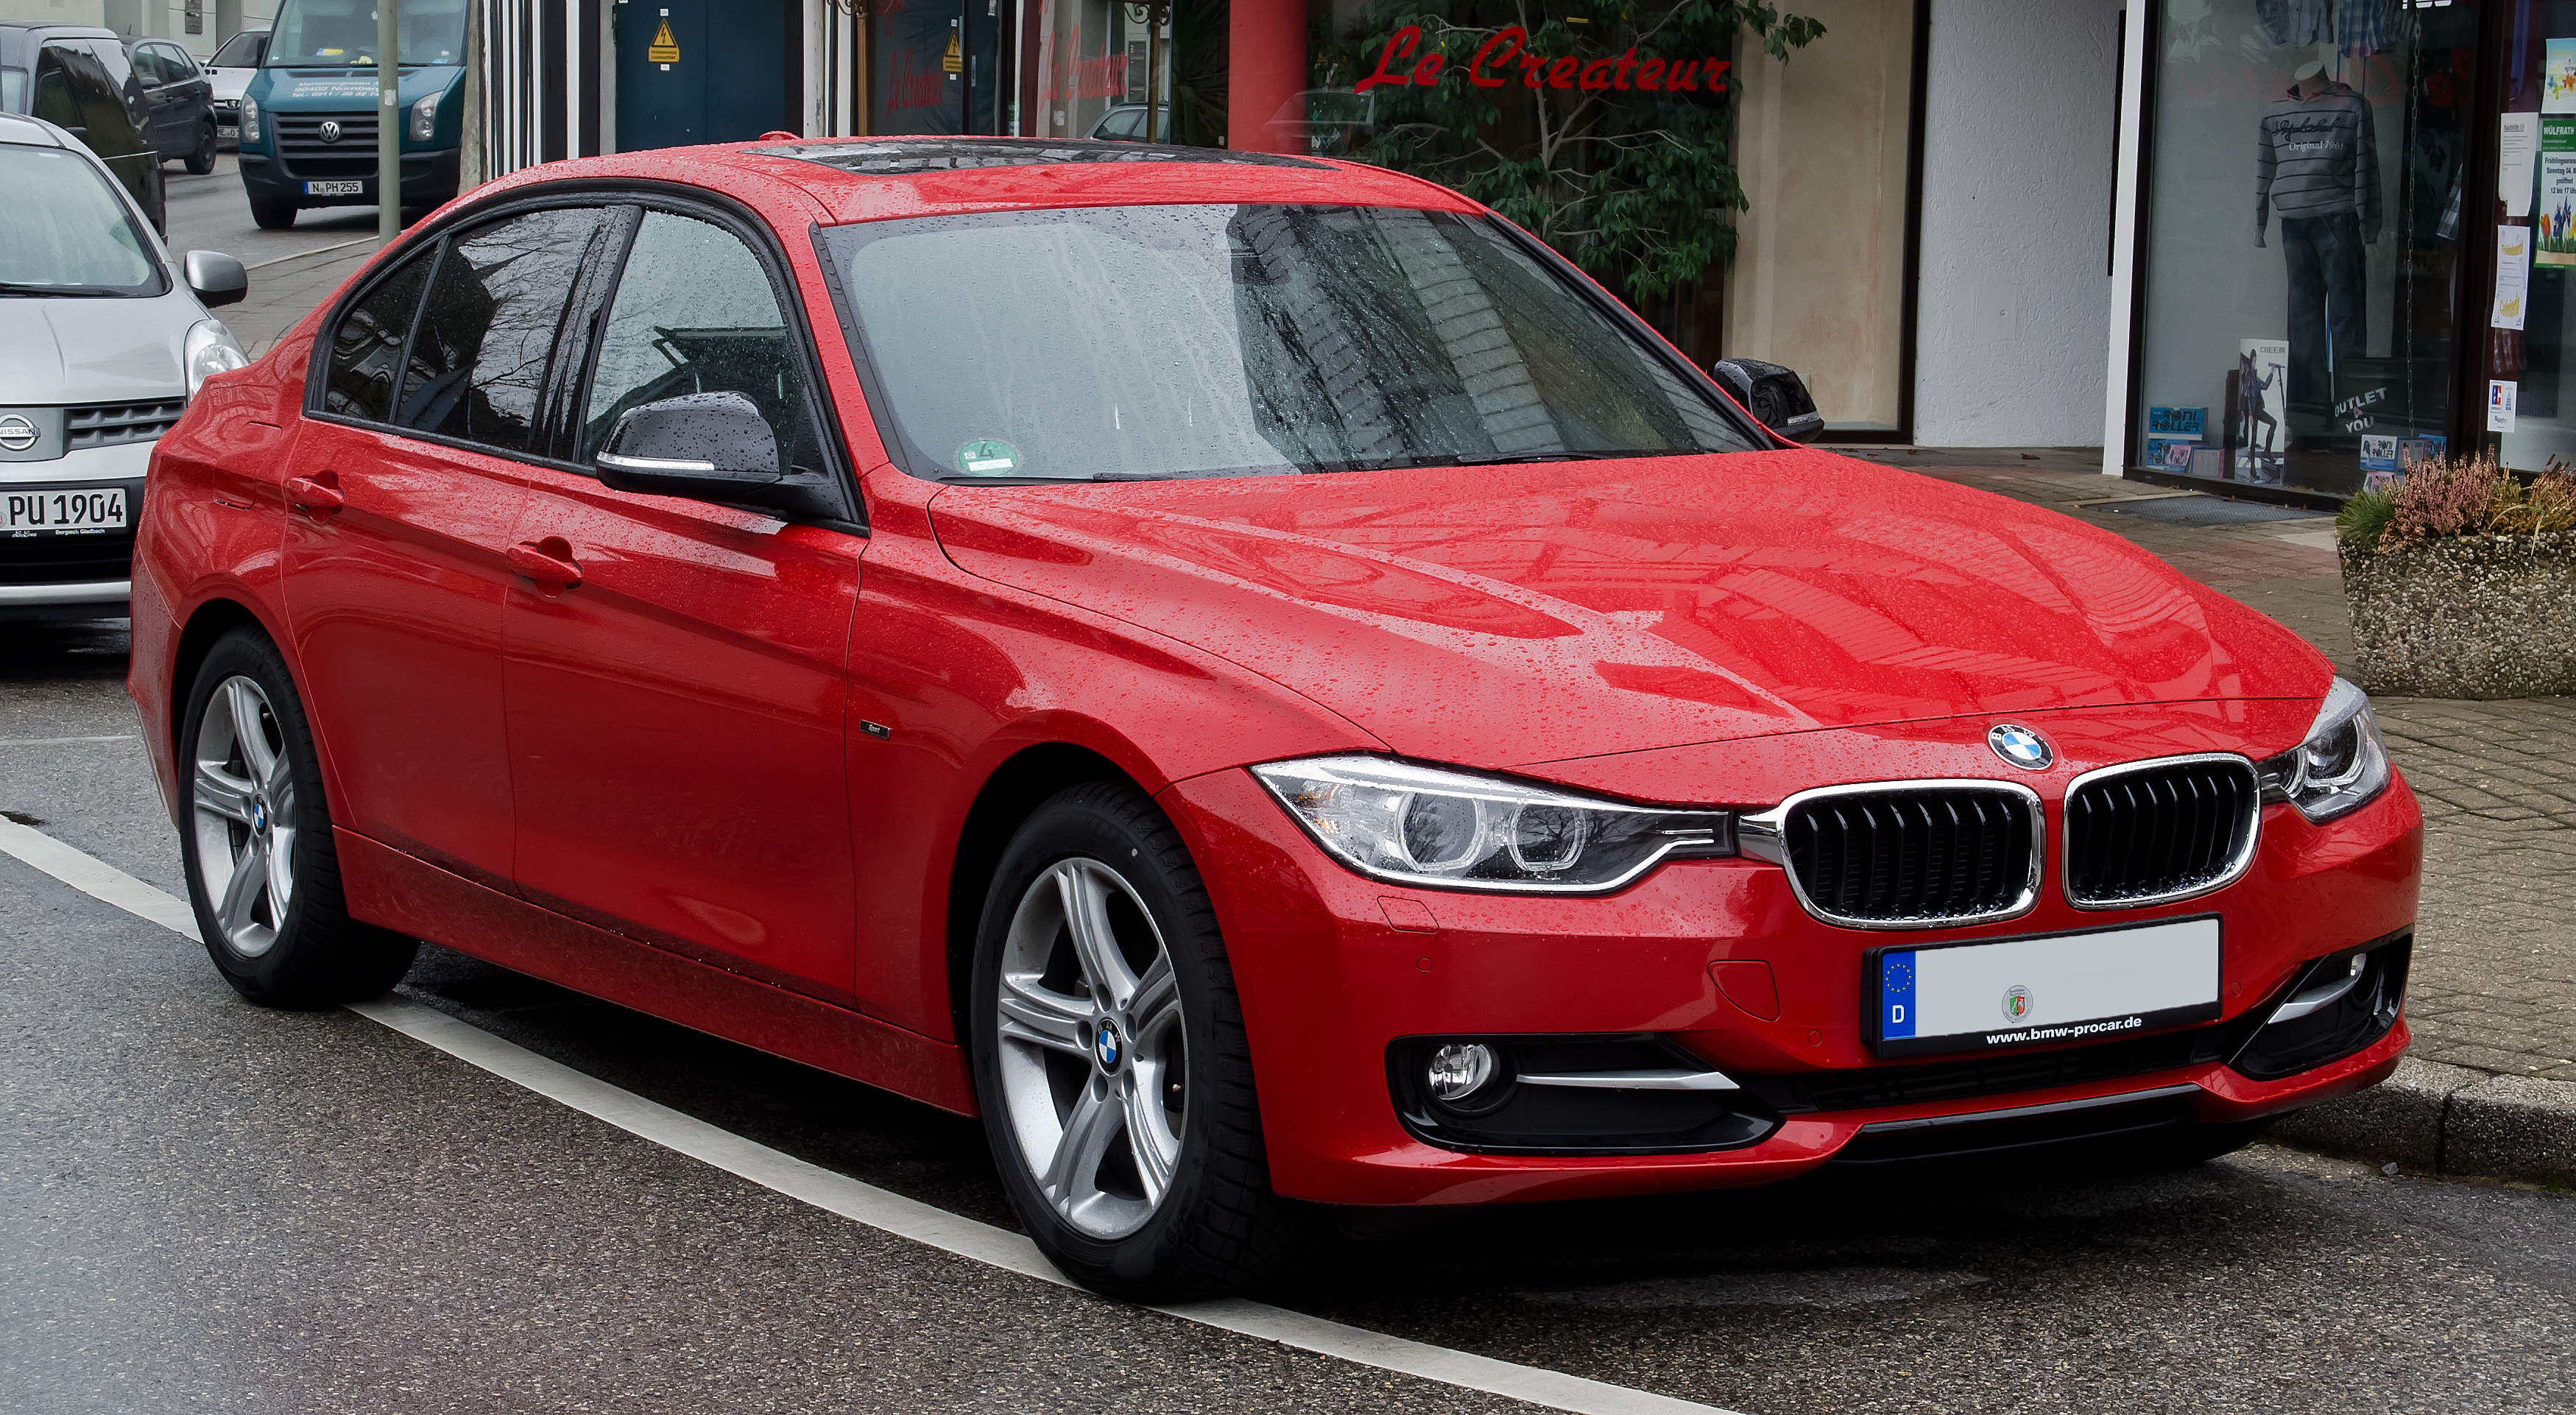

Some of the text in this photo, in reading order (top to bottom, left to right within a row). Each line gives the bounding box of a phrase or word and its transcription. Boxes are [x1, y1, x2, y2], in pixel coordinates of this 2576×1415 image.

[1353, 25, 1731, 93] Le Createur
[2289, 141, 2323, 152] Original
[312, 182, 359, 192] N PH 255
[2335, 387, 2387, 417] OUTLET
[2346, 416, 2374, 434] YOU
[980, 443, 995, 458] 4
[8, 493, 123, 526] PU 1904
[1892, 1005, 1905, 1023] D
[1986, 1016, 2142, 1044] www.bmw-procar.de
